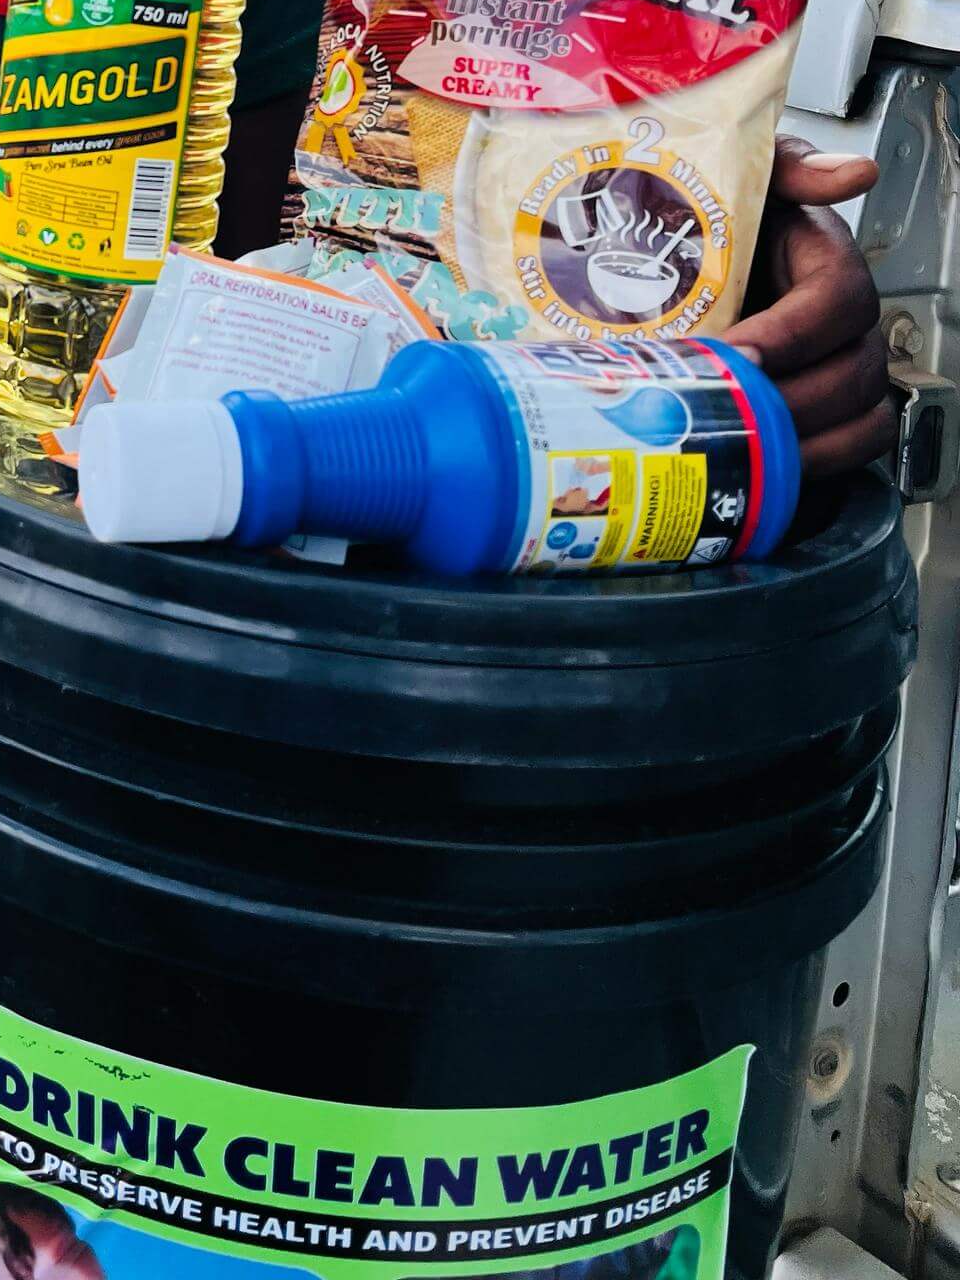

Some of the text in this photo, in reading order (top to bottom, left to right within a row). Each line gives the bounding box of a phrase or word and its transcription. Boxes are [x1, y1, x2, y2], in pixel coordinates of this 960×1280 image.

[133, 6, 189, 25] 750 ml
[430, 18, 573, 60] porridge
[0, 56, 179, 116] ZAMGOLD
[353, 44, 393, 141] NUTRITION
[442, 76, 543, 102] CREAMY
[454, 57, 531, 81] SUPER
[51, 139, 84, 154] behind
[85, 137, 115, 151] every
[520, 116, 729, 250] Ready in 2 Minutes
[190, 271, 221, 288] ORAL
[224, 278, 309, 311] REHYDRATION
[311, 302, 349, 324] SALTS
[516, 255, 546, 300] Stir
[543, 302, 592, 341] into
[654, 286, 717, 341] water
[639, 474, 660, 546] WARNING!
[224, 1136, 478, 1207] CLEAN
[497, 1108, 710, 1204] WATER
[43, 1152, 203, 1222] PRESERVE
[214, 1206, 352, 1248] HEALTH
[362, 1230, 437, 1252] AND
[447, 1213, 599, 1252] PREVENT
[605, 1170, 712, 1229] DISEASE
